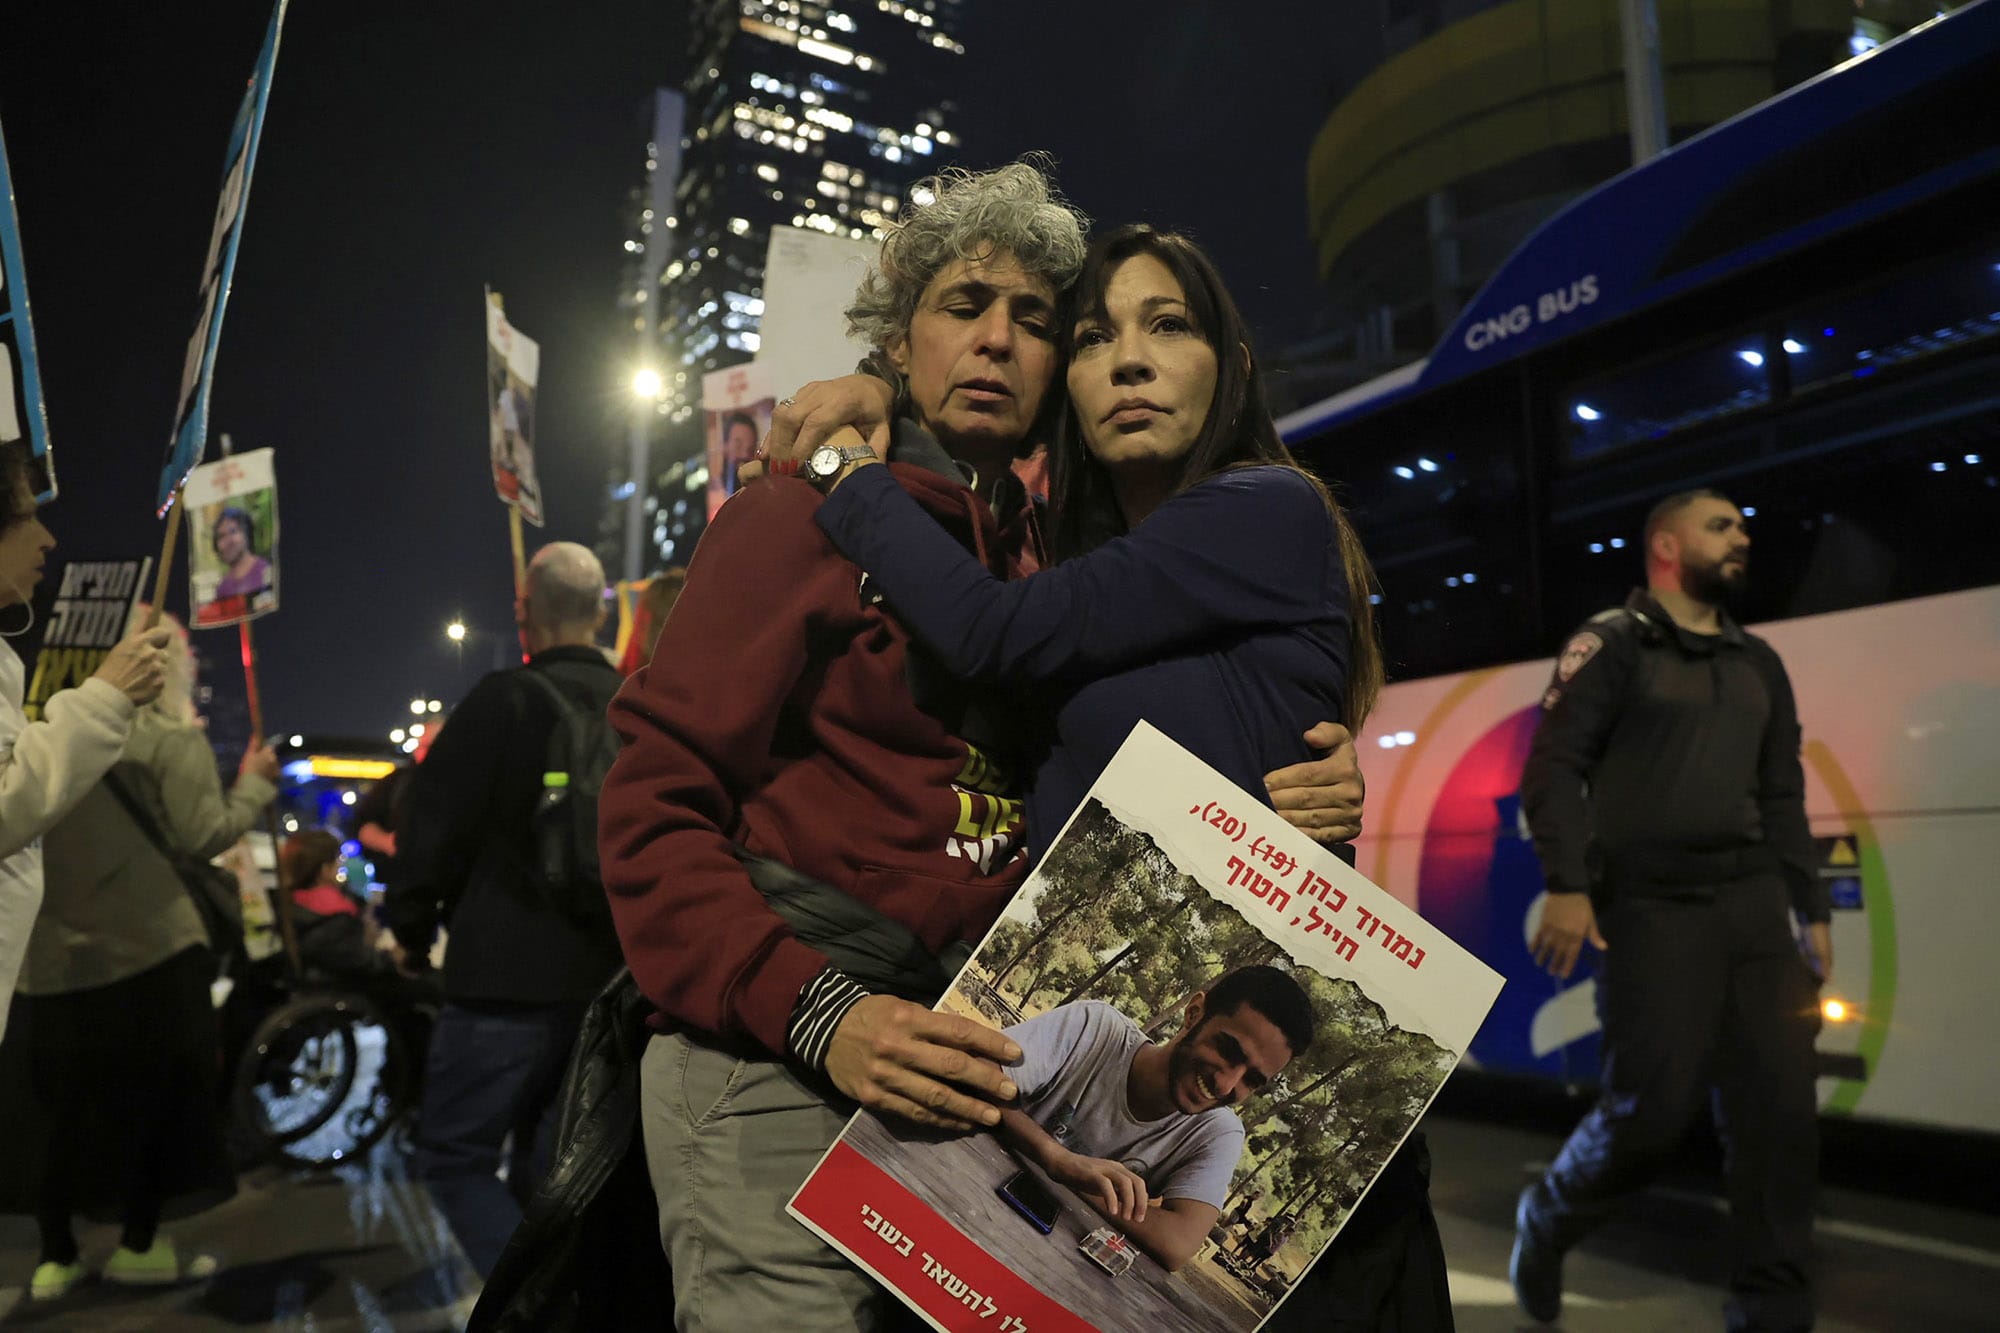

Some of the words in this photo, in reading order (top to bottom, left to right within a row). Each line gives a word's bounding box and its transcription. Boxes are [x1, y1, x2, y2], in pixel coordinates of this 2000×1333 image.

[1465, 304, 1531, 351] CNG
[1537, 274, 1600, 323] BUS
[1190, 800, 1247, 842] (20),
[1226, 855, 1291, 913] חטוף
[1248, 835, 1298, 877] (19)
[1297, 870, 1349, 913] כהן
[1290, 906, 1360, 962] חייל,
[1355, 905, 1427, 970] נמרוד
[860, 1204, 915, 1257] בשבי
[921, 1252, 998, 1319] להשאר
